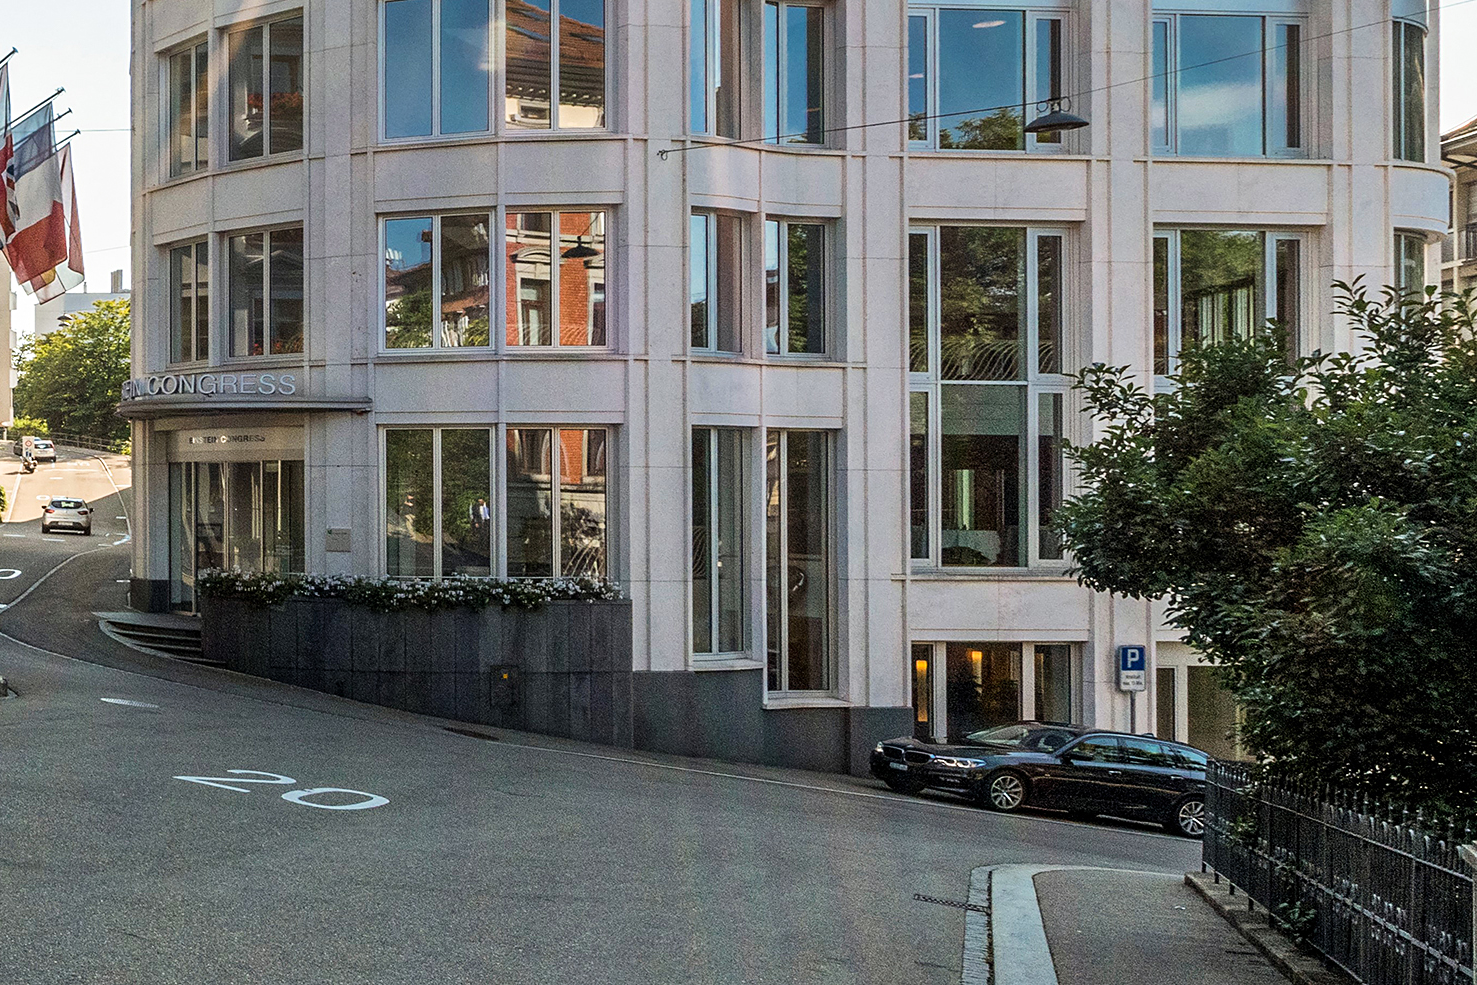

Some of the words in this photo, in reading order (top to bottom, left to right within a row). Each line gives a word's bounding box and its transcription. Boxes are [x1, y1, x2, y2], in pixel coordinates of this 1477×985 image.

[147, 373, 296, 396] CONGRESS
[189, 436, 218, 444] EINSTEIN
[220, 434, 266, 444] CONGRESS
[1127, 649, 1140, 669] P
[173, 769, 390, 810] 20
